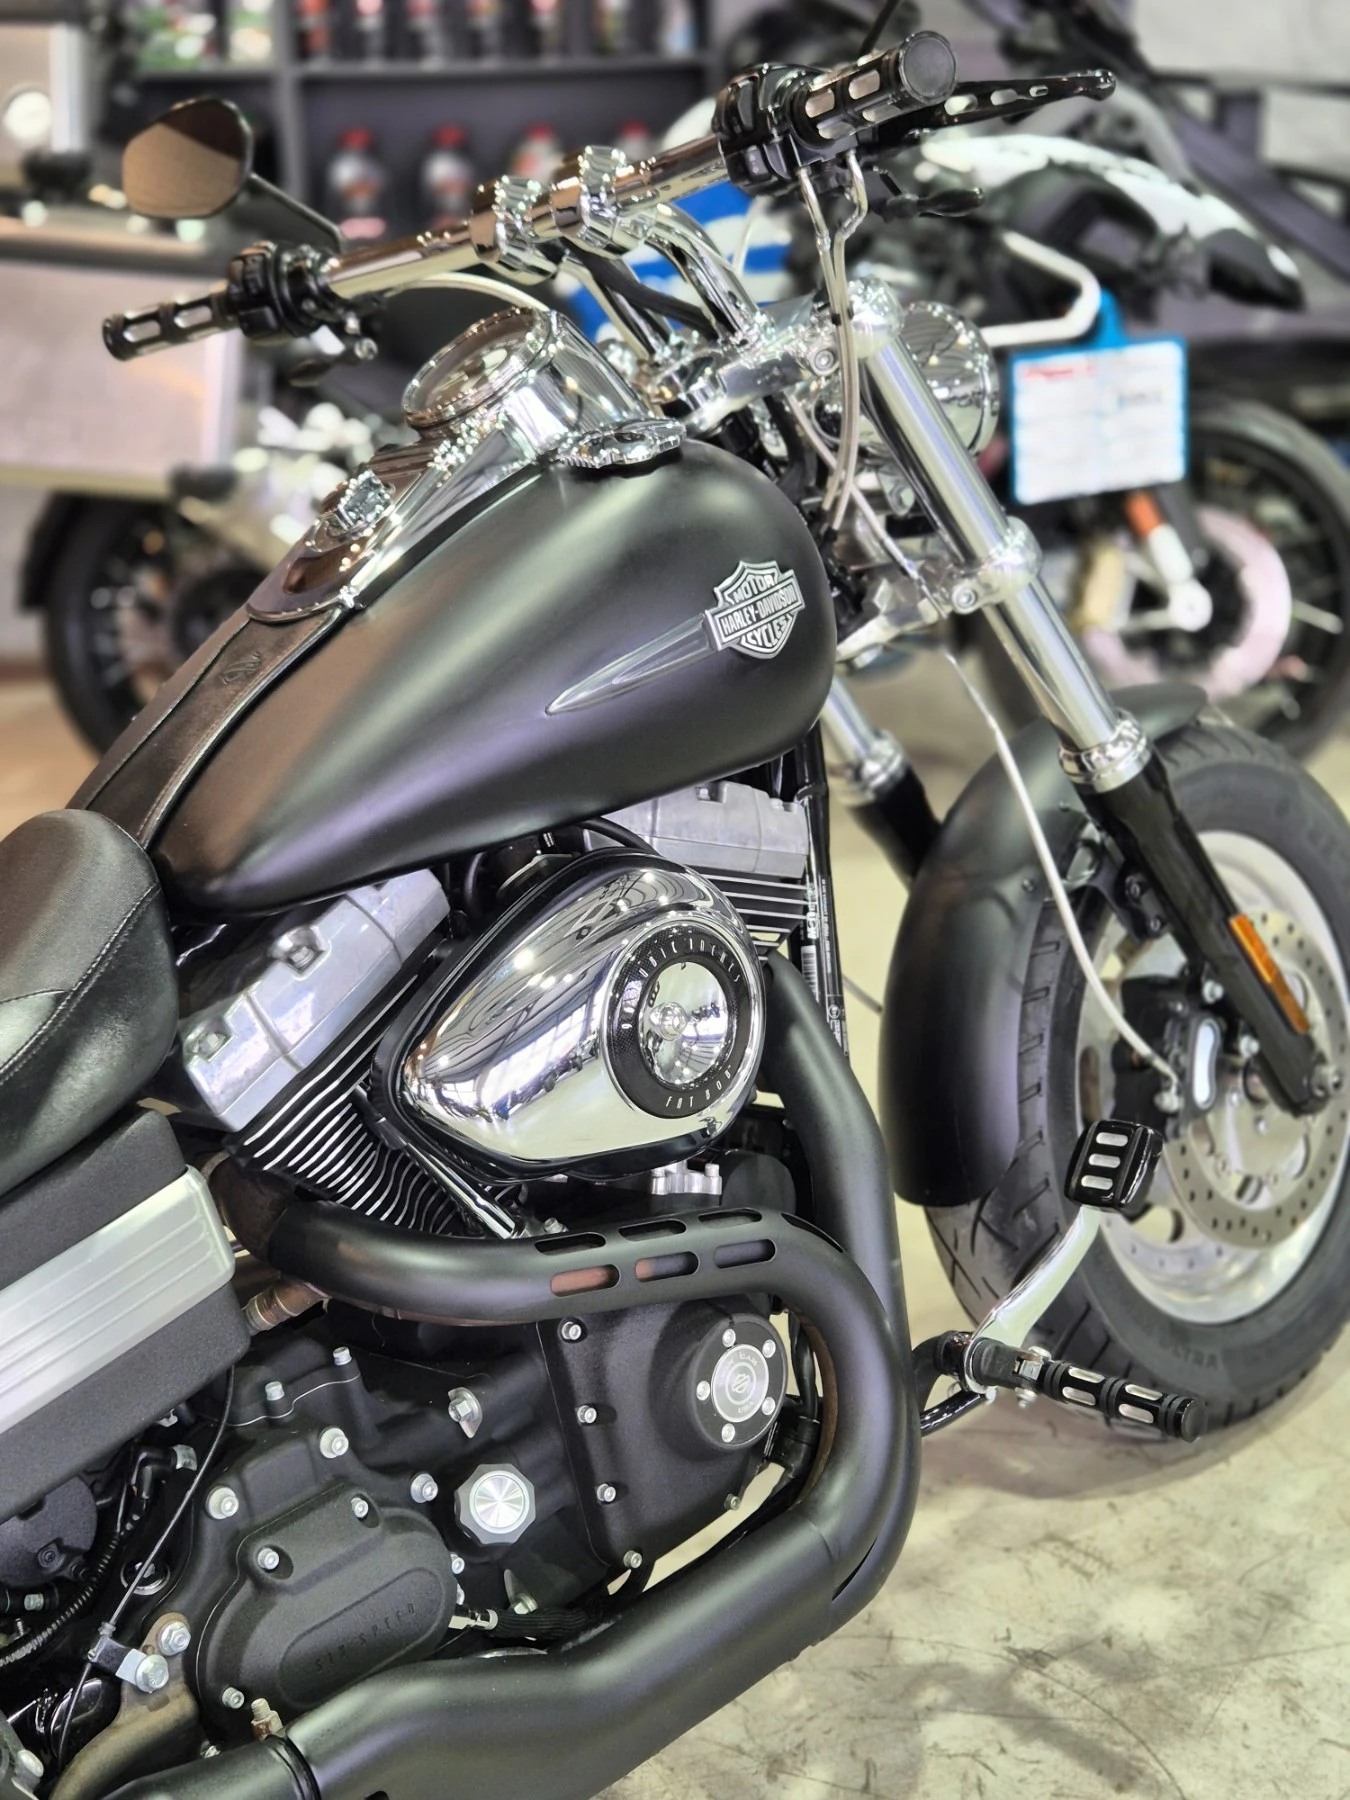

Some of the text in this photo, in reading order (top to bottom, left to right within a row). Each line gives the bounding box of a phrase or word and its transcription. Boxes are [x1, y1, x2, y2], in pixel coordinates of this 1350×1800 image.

[720, 583, 798, 636] HARLEY-DAVIDSON
[733, 574, 776, 604] MOTOR
[746, 615, 788, 648] CYCLES
[665, 1068, 731, 1109] FAT BOB
[314, 1603, 416, 1673] SIX SPEED
